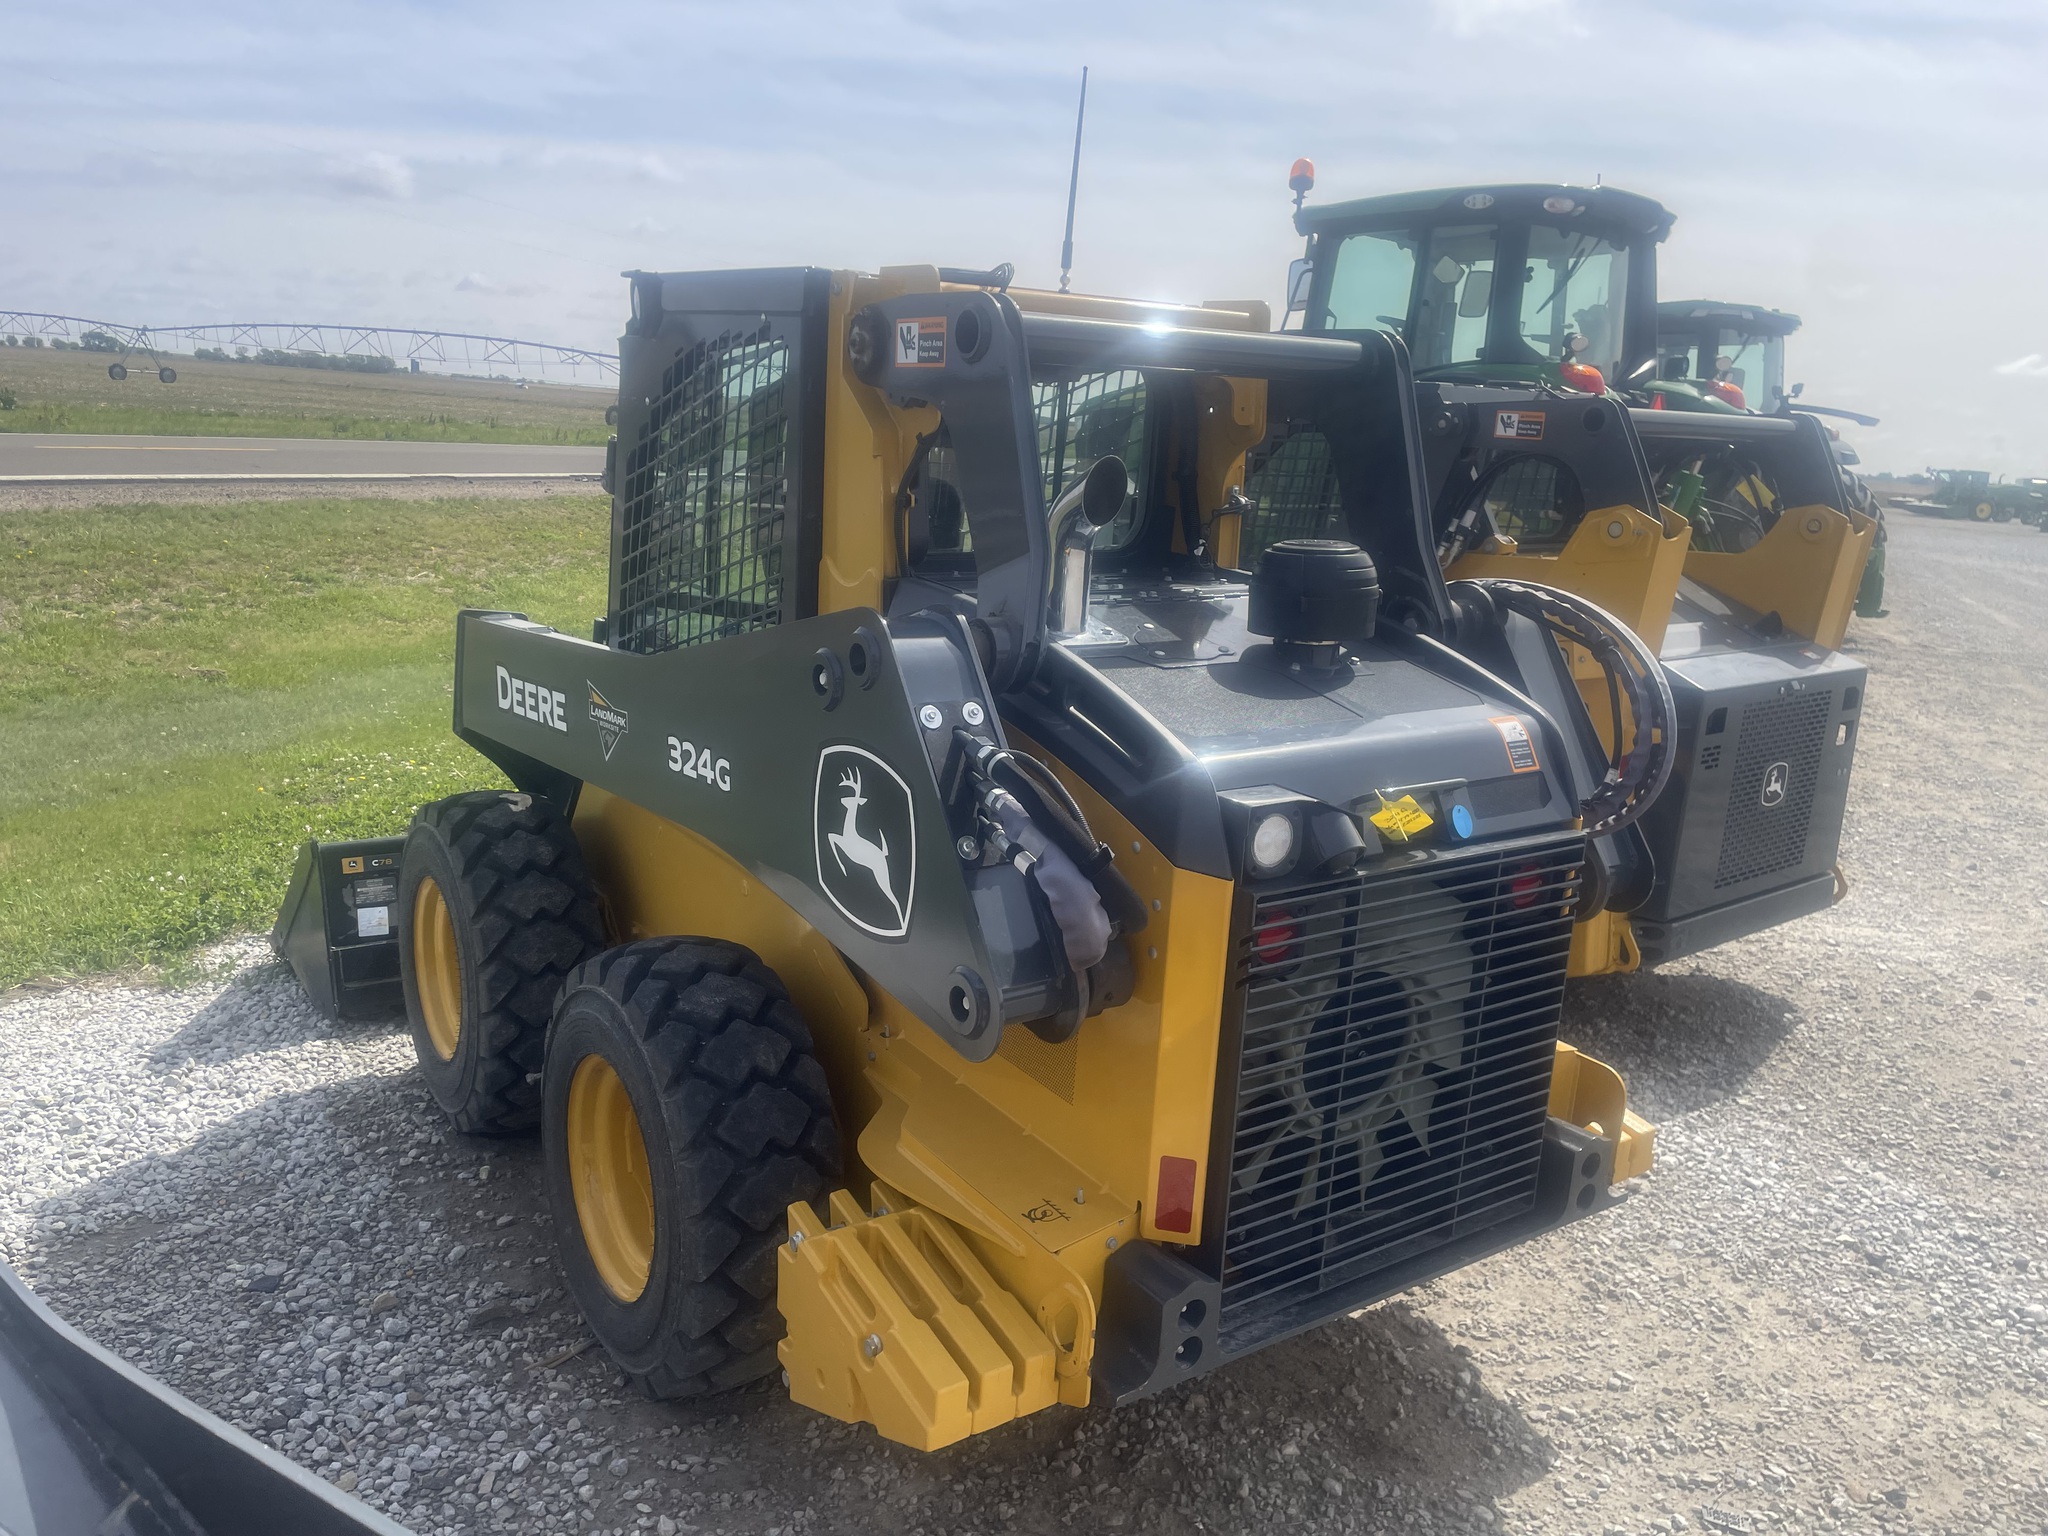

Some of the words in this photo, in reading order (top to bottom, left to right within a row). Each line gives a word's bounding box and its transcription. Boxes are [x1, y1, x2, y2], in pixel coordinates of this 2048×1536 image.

[919, 339, 932, 347] Pinch
[933, 339, 943, 347] Area
[919, 350, 929, 358] Keep
[929, 350, 939, 358] Away
[496, 664, 568, 733] DEERE
[590, 704, 627, 728] LANDMARK
[667, 735, 732, 792] 324G
